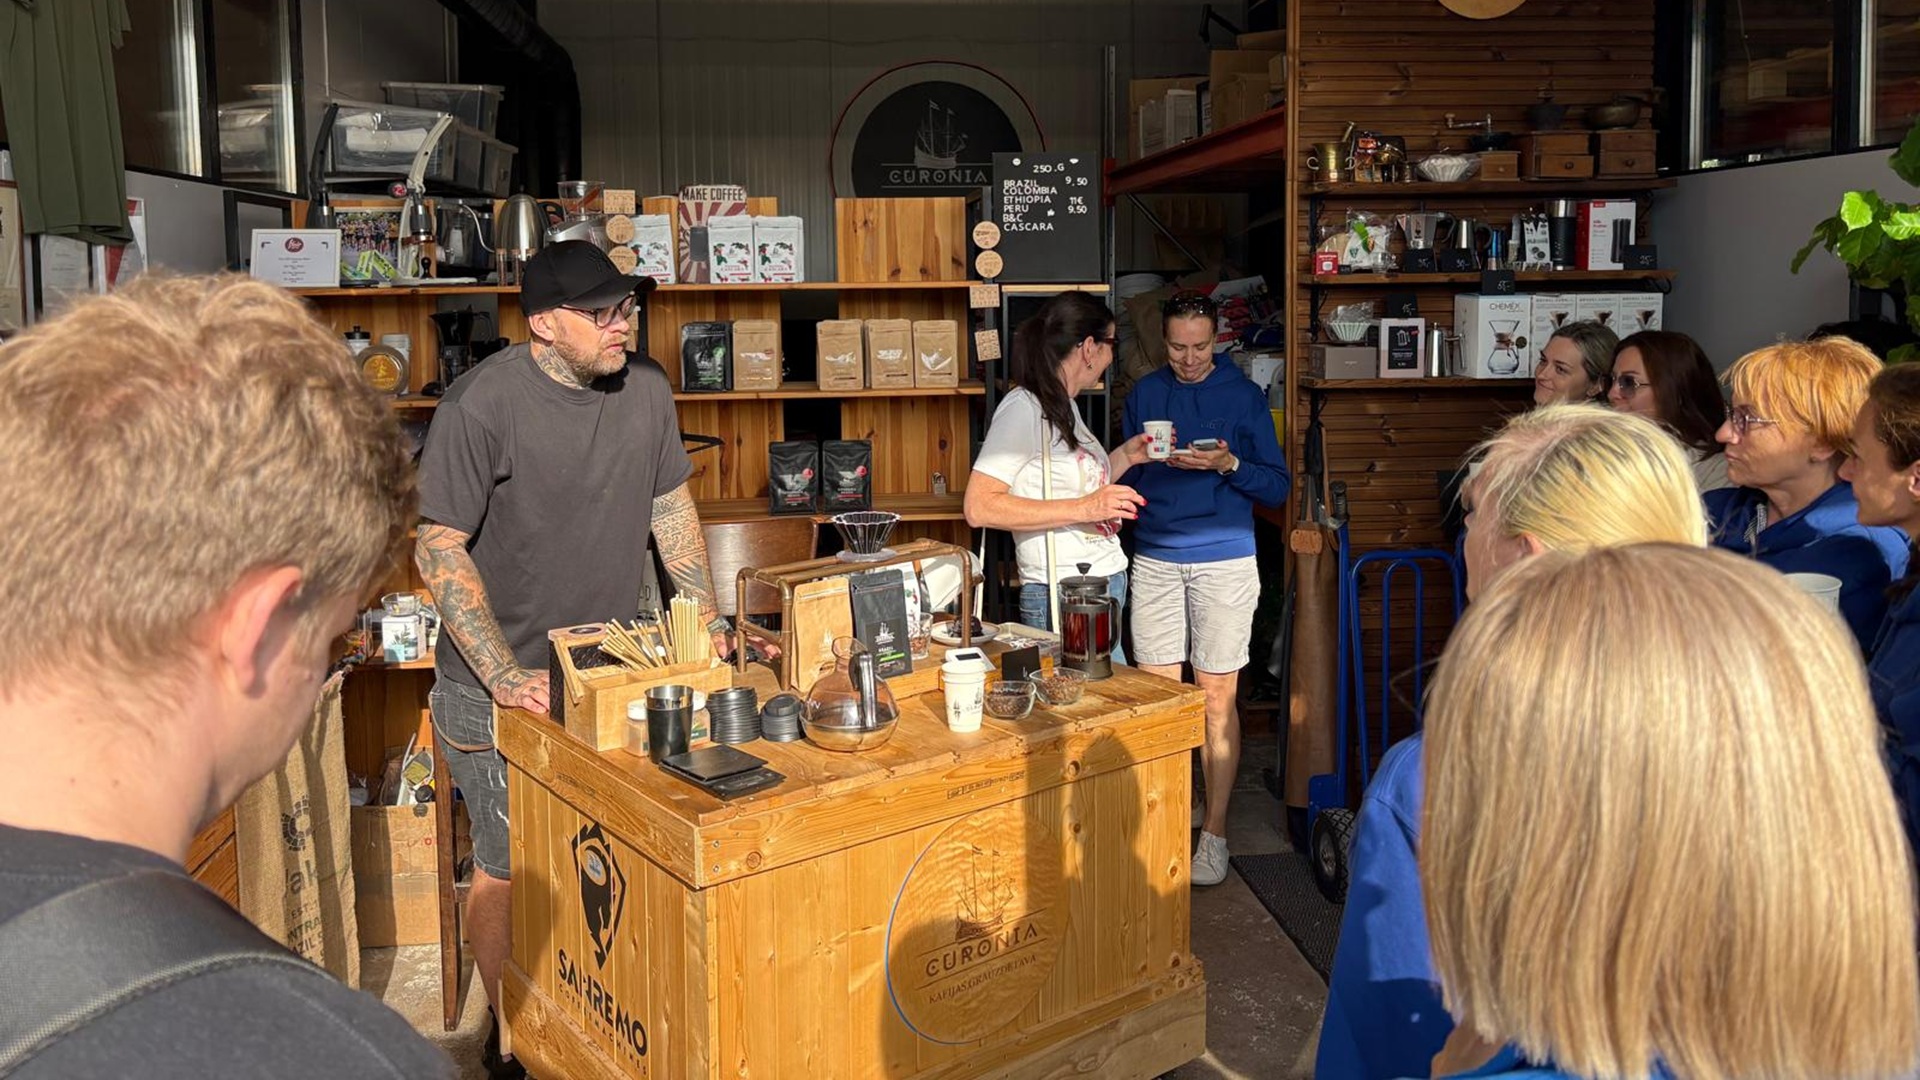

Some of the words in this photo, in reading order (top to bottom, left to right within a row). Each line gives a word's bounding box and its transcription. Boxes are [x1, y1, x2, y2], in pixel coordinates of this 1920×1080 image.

[889, 169, 988, 184] CURONIA
[1003, 179, 1040, 188] BRAZIL
[682, 187, 708, 201] MAKE
[710, 187, 744, 201] COFFEE
[1003, 186, 1058, 196] COLOMBIA
[1003, 195, 1052, 204] ETHIOPIA
[1003, 204, 1029, 213] PERU
[1002, 213, 1024, 223] B&C
[1003, 222, 1055, 232] CASCARA
[926, 923, 1038, 977] CURONIA
[559, 948, 648, 1057] SANREMO
